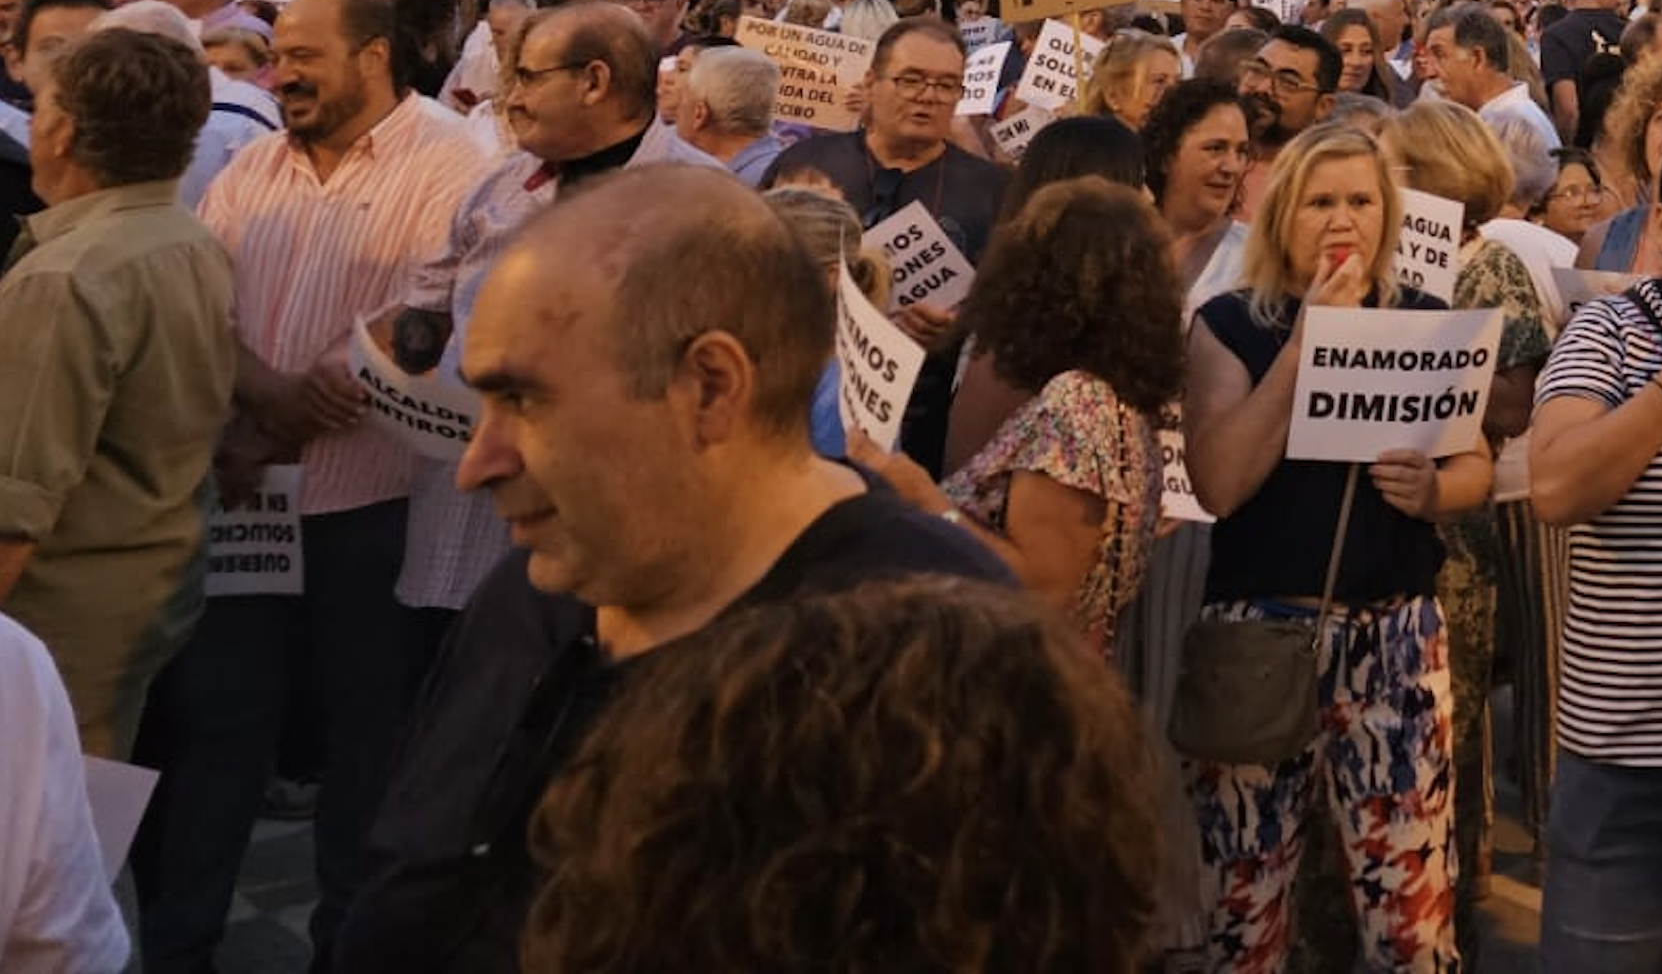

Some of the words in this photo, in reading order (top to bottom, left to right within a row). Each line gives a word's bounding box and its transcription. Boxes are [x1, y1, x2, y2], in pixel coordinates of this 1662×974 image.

[780, 27, 802, 42] UN
[805, 33, 846, 50] AGUA
[848, 41, 867, 55] DE
[819, 73, 838, 86] LA
[1032, 74, 1056, 93] EN
[807, 89, 836, 105] DEL
[1402, 213, 1452, 243] AGUA
[893, 240, 947, 283] ONES
[1409, 242, 1422, 259] Y
[1424, 246, 1450, 270] DE
[898, 265, 959, 306] AGUA
[1312, 346, 1489, 371] ENAMORADO
[358, 366, 472, 427] ALCALDE
[1307, 385, 1480, 423] DIMISIÓN
